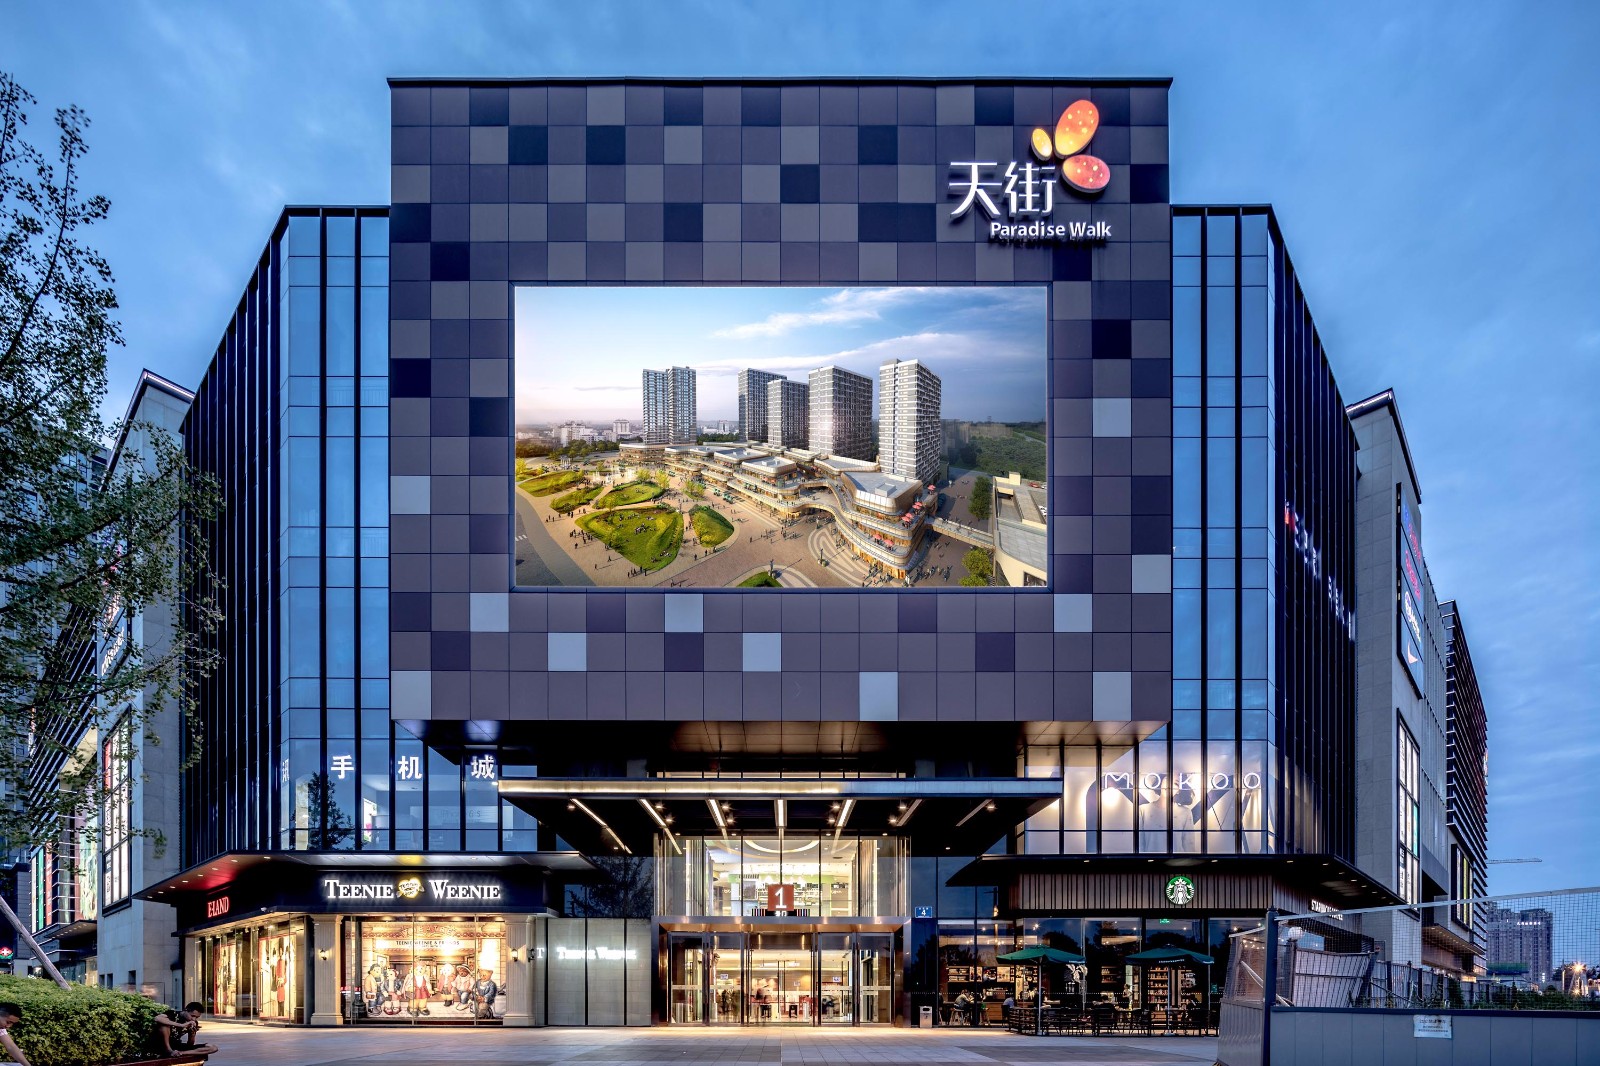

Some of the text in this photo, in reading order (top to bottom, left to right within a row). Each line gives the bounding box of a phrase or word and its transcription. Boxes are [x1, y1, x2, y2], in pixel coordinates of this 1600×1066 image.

[948, 161, 1057, 217] 天街
[990, 221, 1112, 239] Paradise Walk
[1104, 772, 1261, 790] MOKOO
[324, 879, 394, 899] TEENIE
[428, 879, 501, 900] WEENIE
[774, 887, 787, 909] 1
